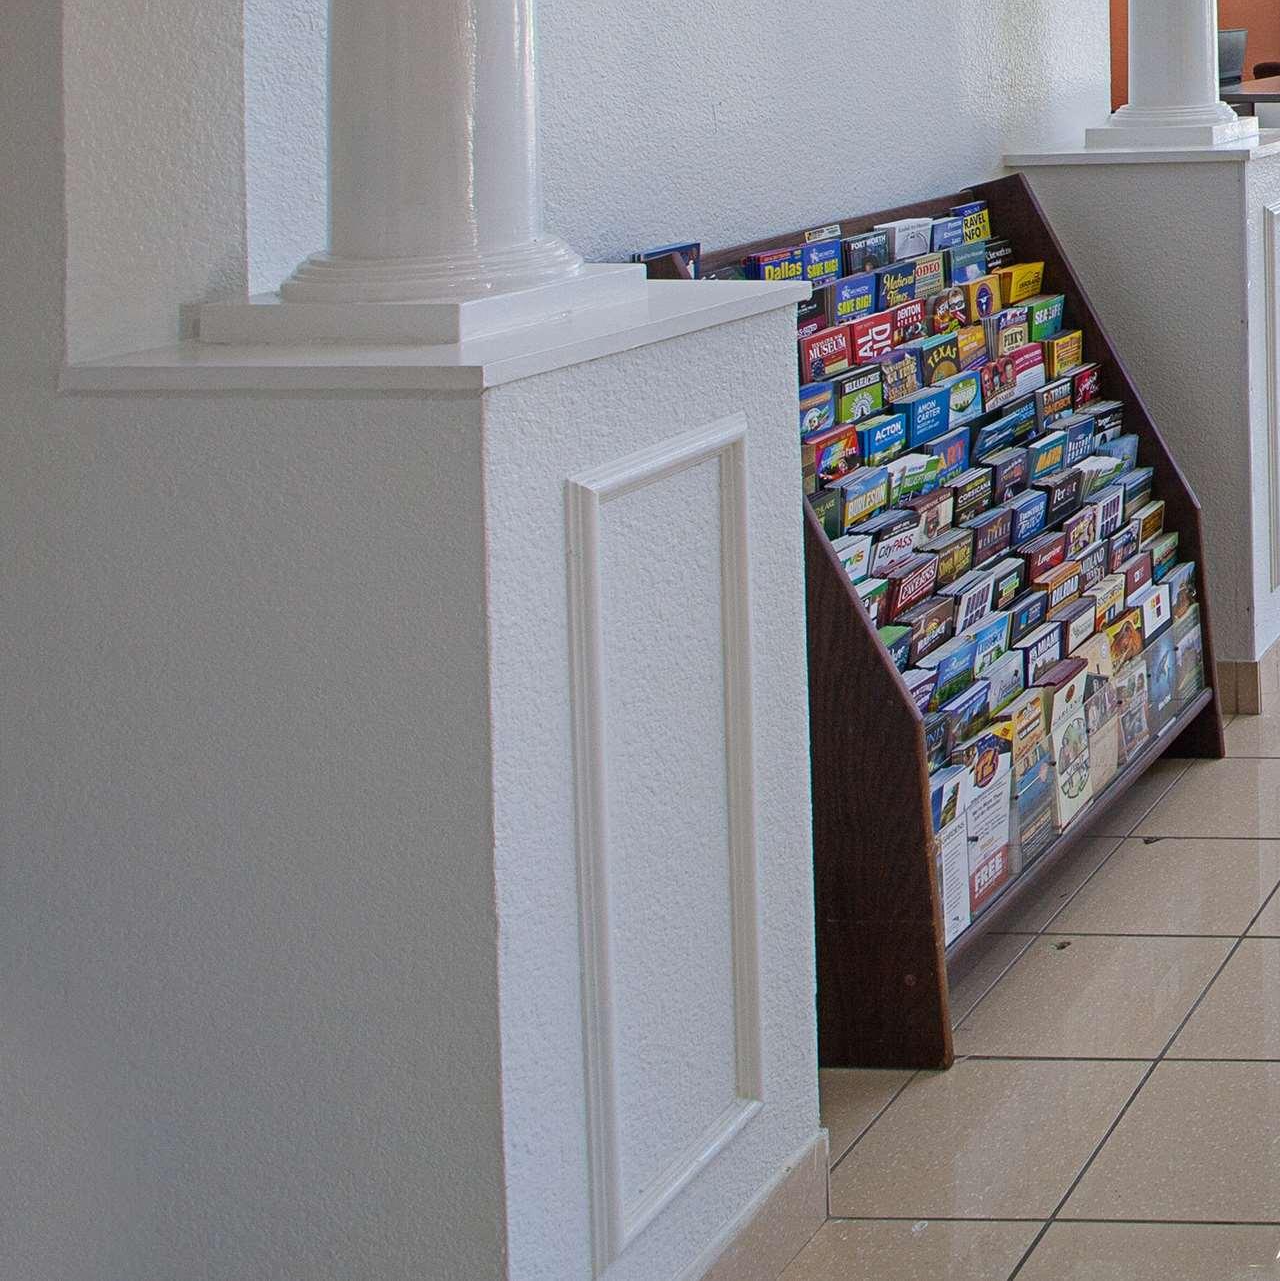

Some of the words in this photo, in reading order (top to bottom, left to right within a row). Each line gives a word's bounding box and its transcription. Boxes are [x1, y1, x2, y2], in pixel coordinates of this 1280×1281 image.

[963, 212, 986, 230] RAVEL
[964, 227, 981, 242] NFO
[764, 261, 803, 280] Dallas
[806, 261, 824, 279] SAVE
[916, 262, 940, 279] ODEO
[837, 300, 855, 316] SAVE
[897, 302, 921, 321] DENTON
[1034, 308, 1049, 325] SEA
[808, 337, 848, 361] MUSEUM
[927, 344, 958, 368] TEXAS
[916, 406, 941, 424] CARTER
[974, 850, 1003, 888] FREE
